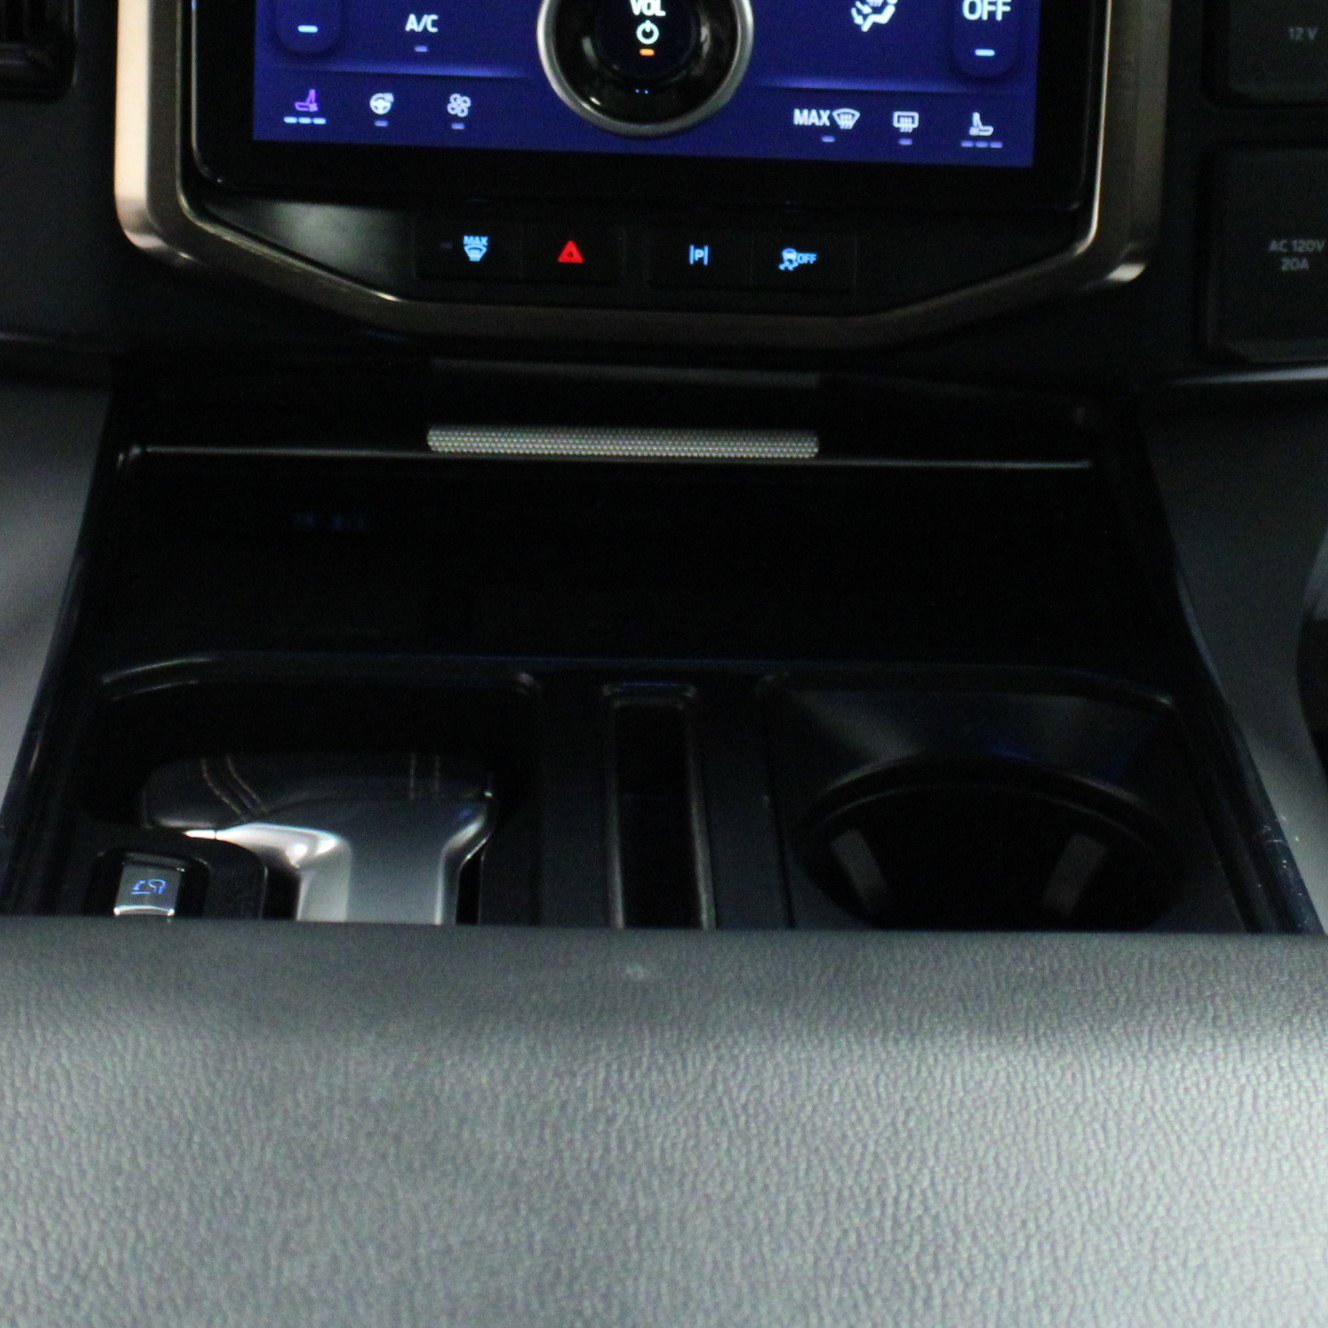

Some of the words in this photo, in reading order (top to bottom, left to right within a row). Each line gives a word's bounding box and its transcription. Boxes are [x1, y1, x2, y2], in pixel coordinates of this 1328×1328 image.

[405, 13, 439, 33] A/C
[793, 108, 831, 127] MAX
[463, 235, 488, 247] MAX
[1269, 239, 1288, 253] AC
[1291, 239, 1326, 253] 120V
[795, 252, 818, 266] OFF
[1281, 257, 1310, 272] 20A
